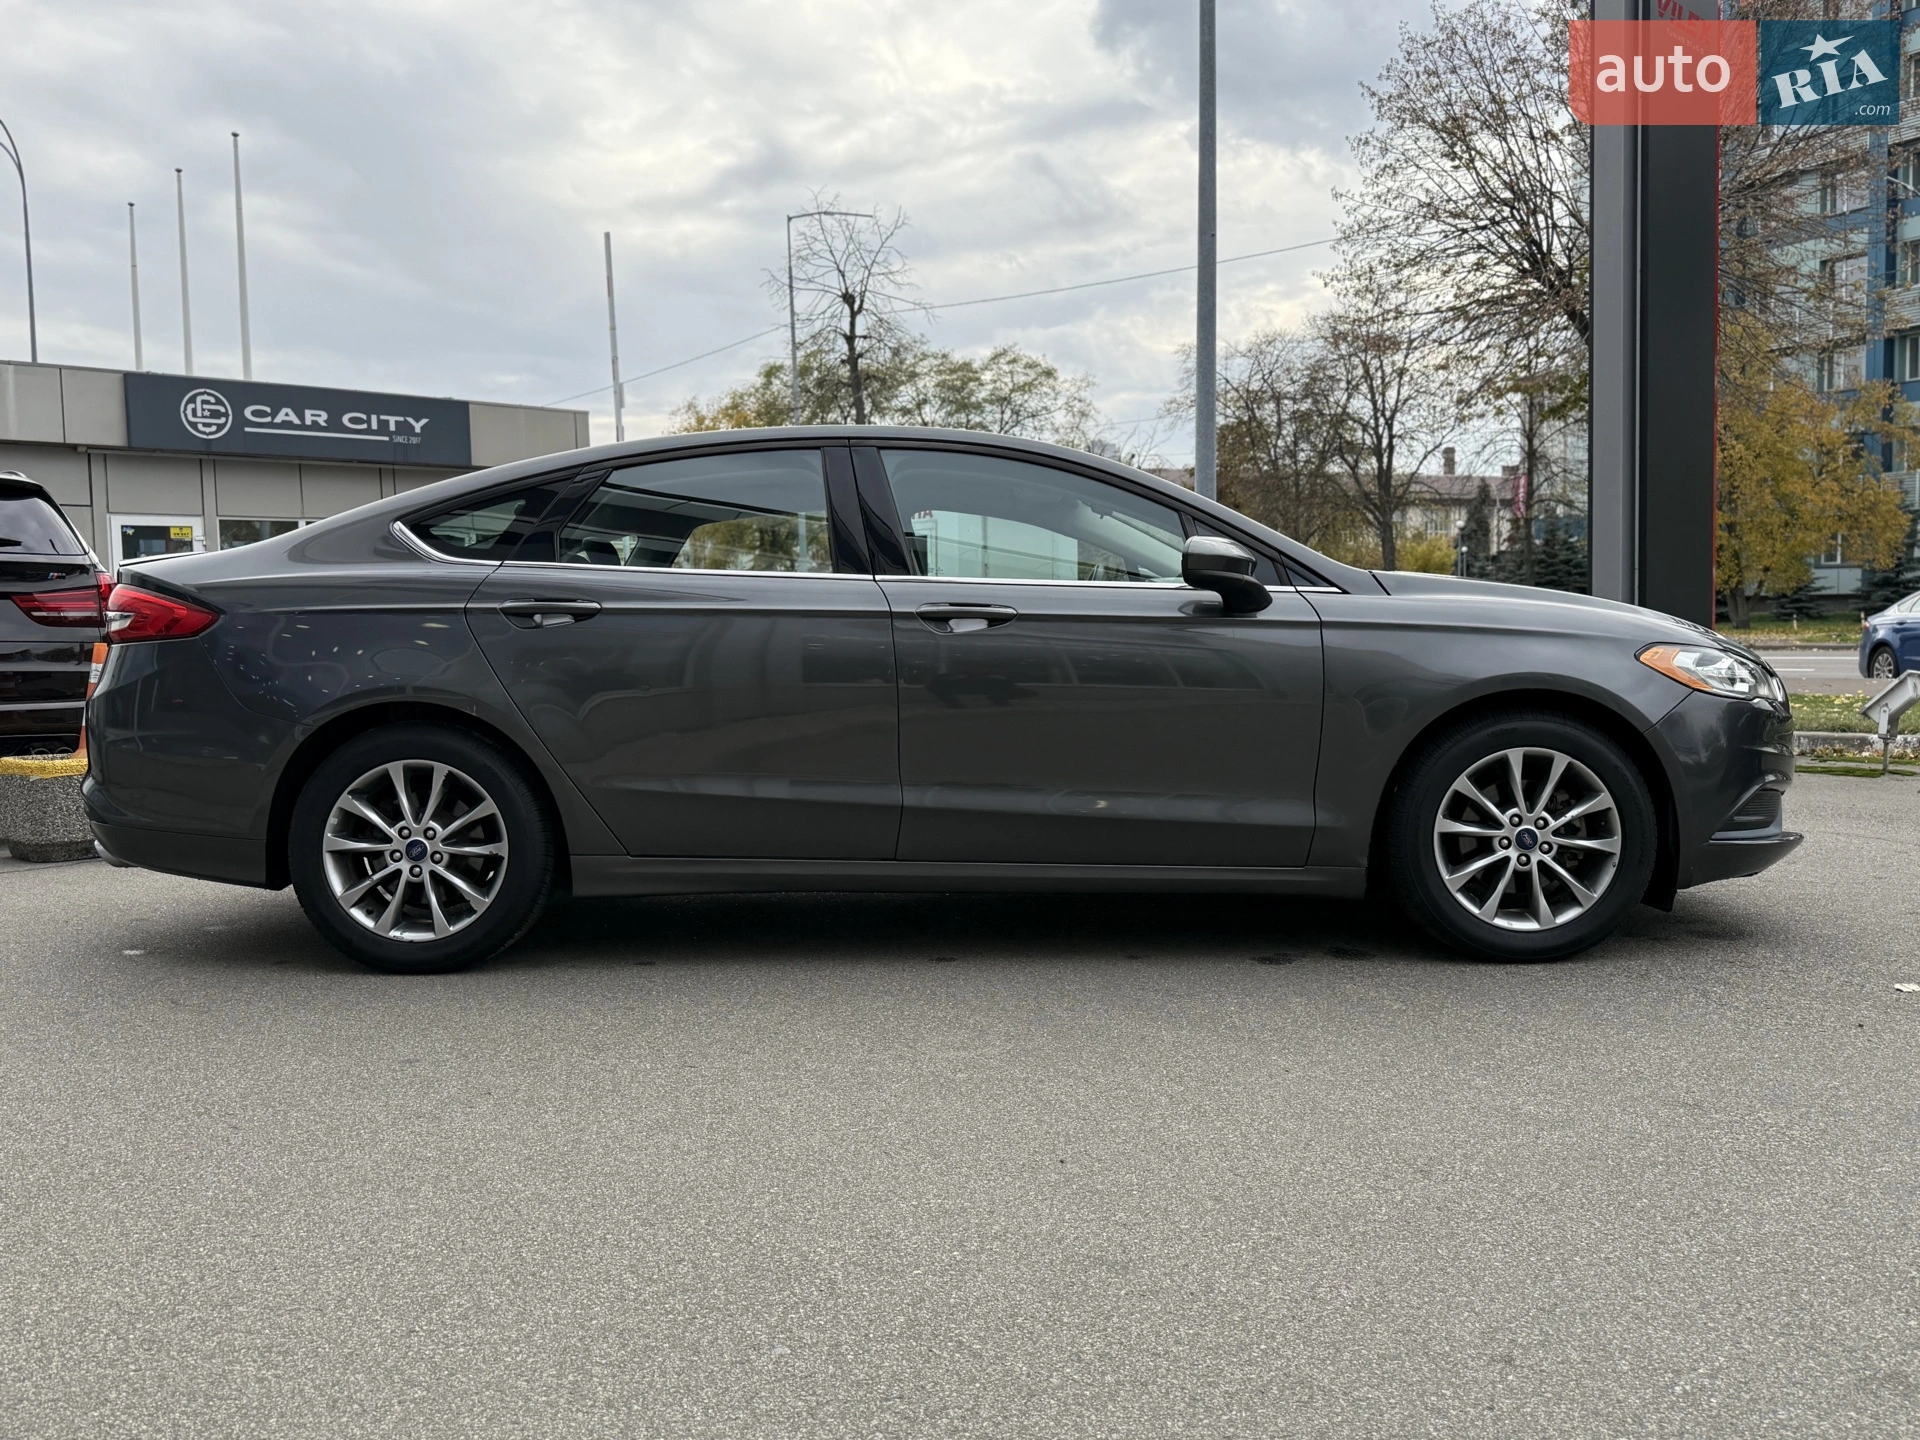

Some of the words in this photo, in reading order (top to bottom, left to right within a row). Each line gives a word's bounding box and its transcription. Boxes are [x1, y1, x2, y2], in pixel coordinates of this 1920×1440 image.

[243, 404, 328, 427] CAR
[341, 412, 430, 434] CITY
[392, 434, 408, 444] SINCE
